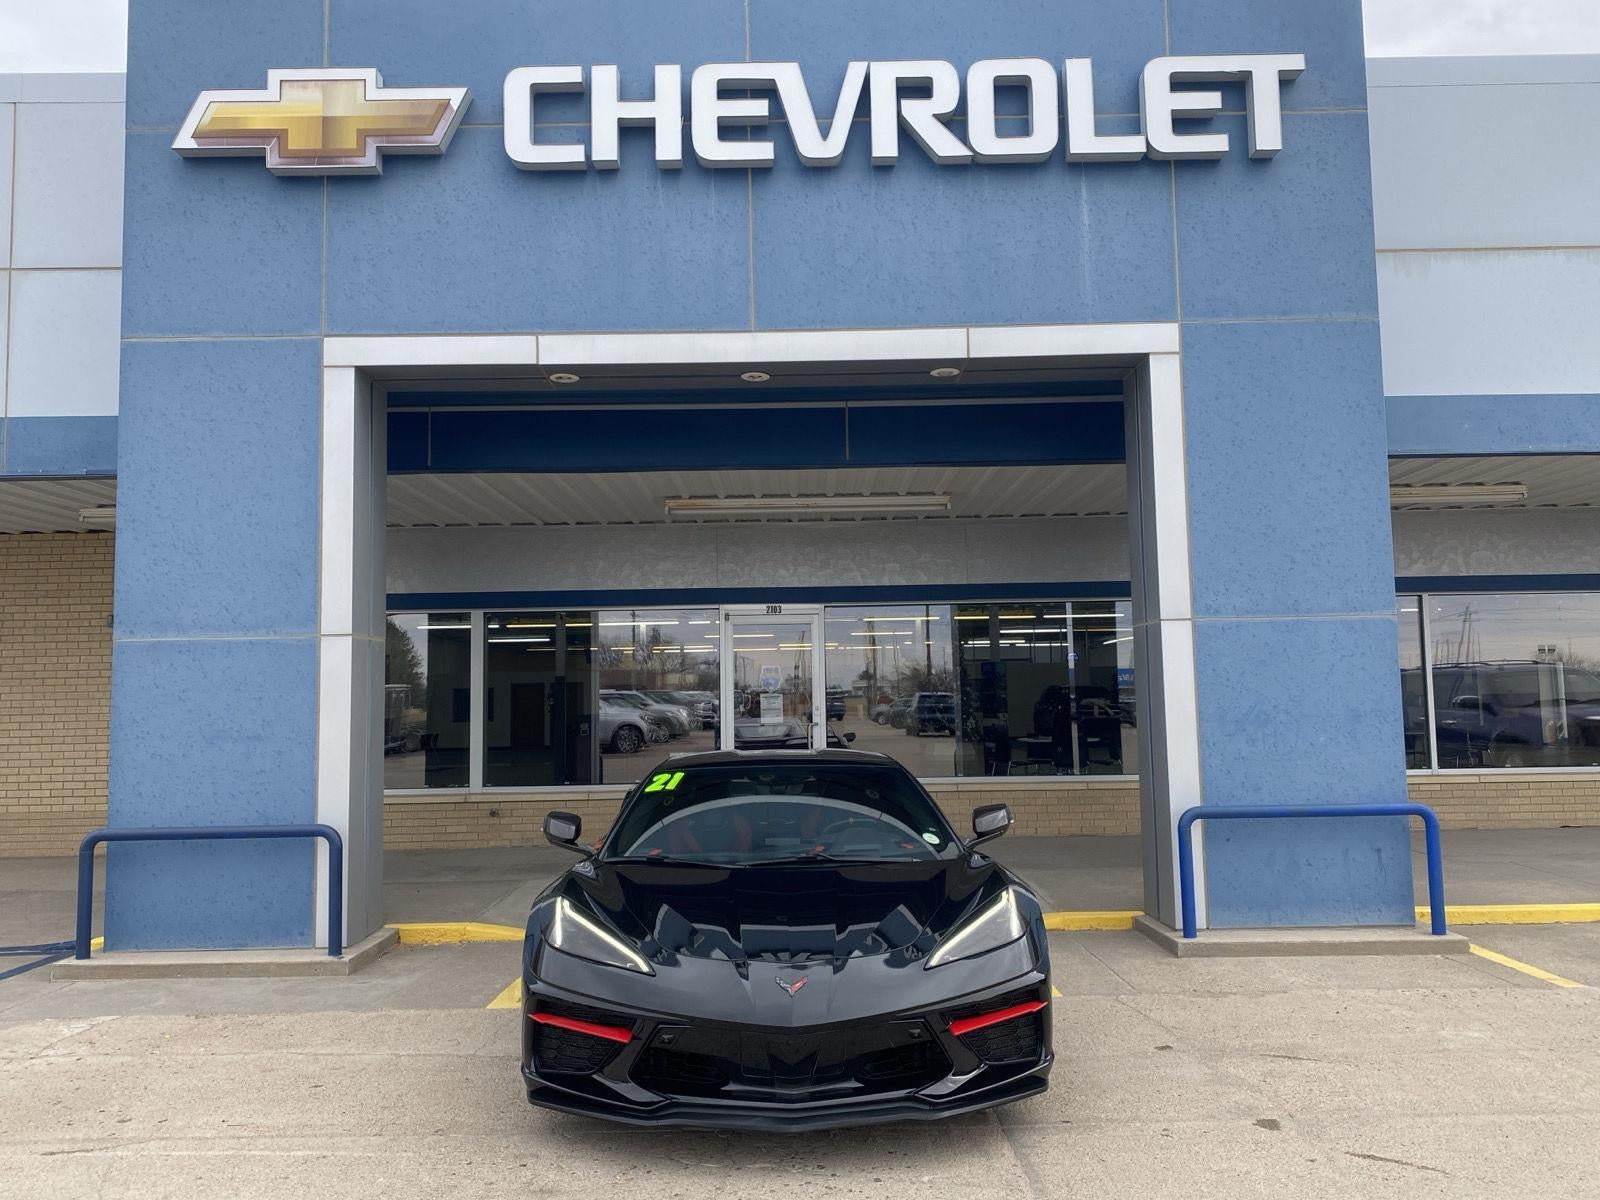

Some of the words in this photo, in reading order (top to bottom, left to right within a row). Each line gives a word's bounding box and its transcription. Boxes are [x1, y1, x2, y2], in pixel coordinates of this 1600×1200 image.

[503, 54, 1306, 171] CHEVROLET
[766, 605, 782, 614] 2103
[644, 772, 685, 792] 21
